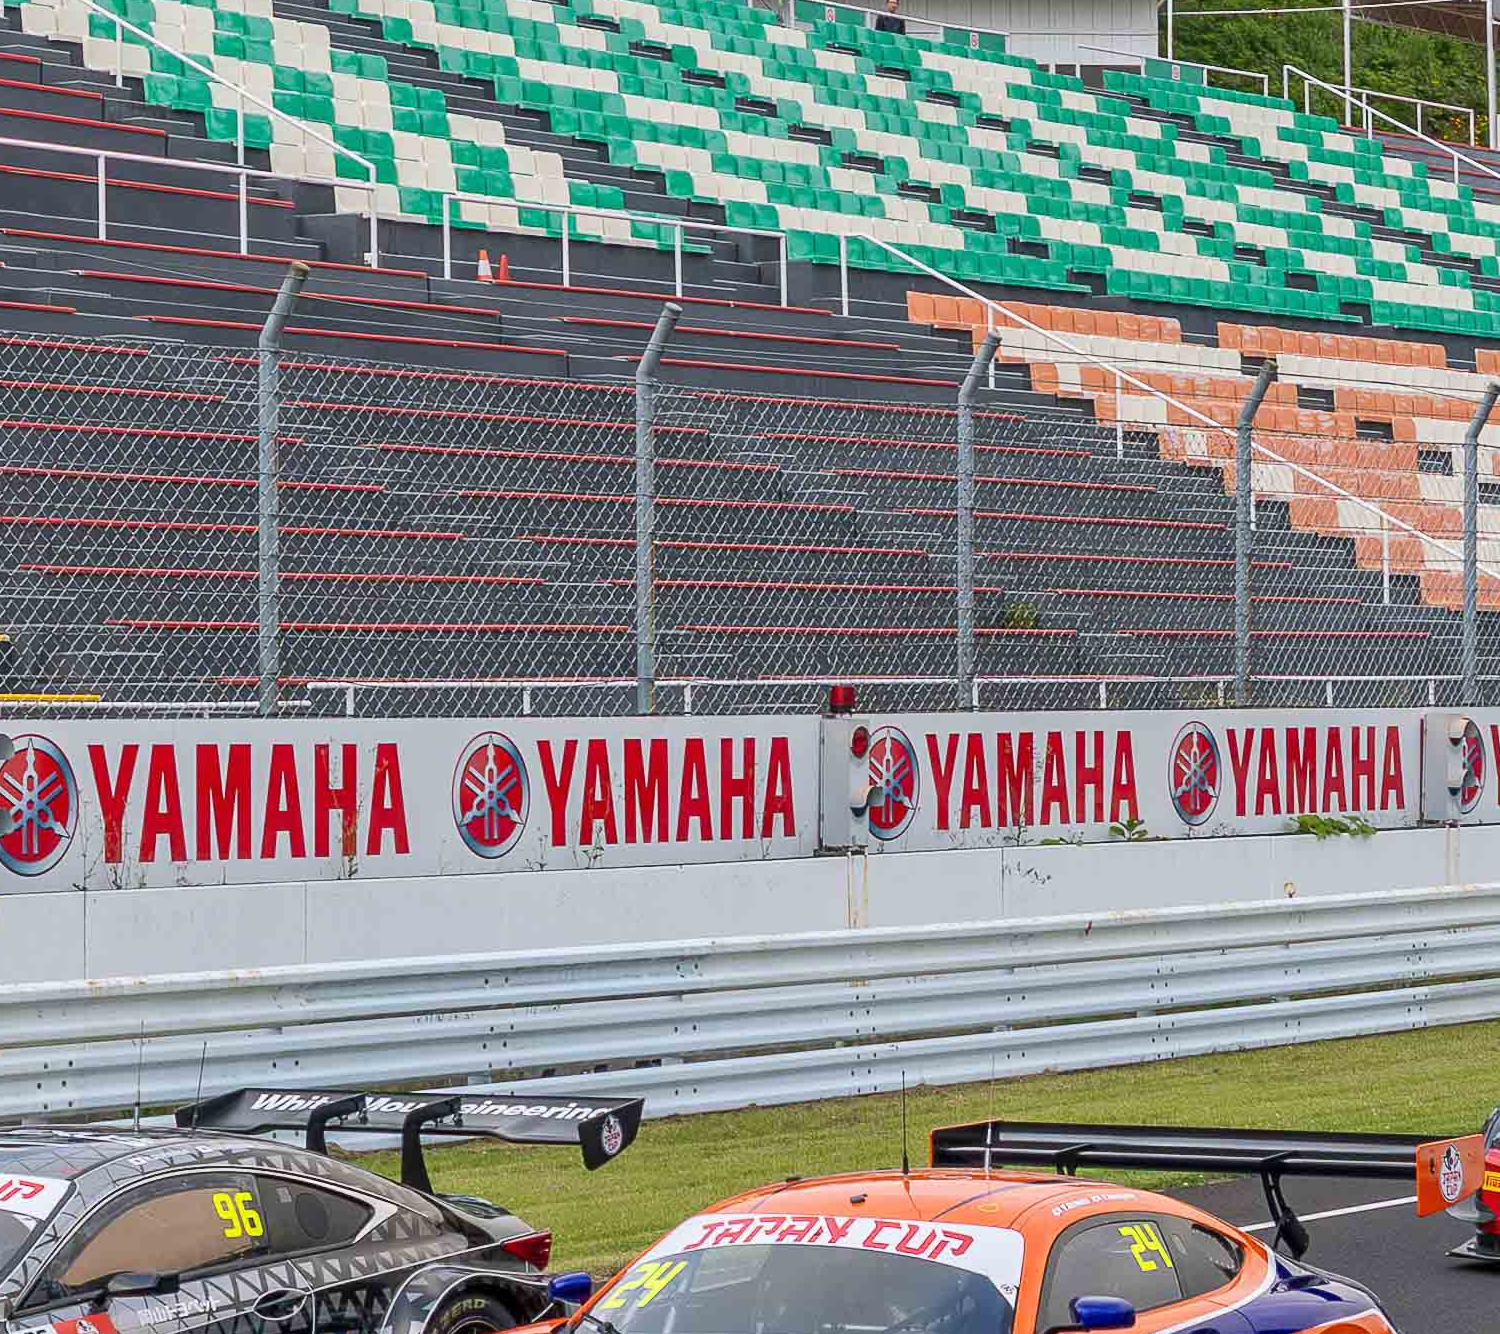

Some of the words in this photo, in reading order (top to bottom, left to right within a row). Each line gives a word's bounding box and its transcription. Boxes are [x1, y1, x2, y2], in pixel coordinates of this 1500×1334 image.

[536, 737, 796, 848] YAMAHA
[925, 730, 1140, 830] YAMAHA
[1226, 725, 1406, 816] YAMAHA
[88, 742, 410, 864] YAMAHA
[250, 1092, 332, 1113] Whit
[211, 1190, 264, 1239] 96
[684, 1216, 858, 1252] JAPAN
[862, 1219, 975, 1260] CUP
[1116, 1221, 1173, 1273] 24
[597, 1259, 688, 1310] 24
